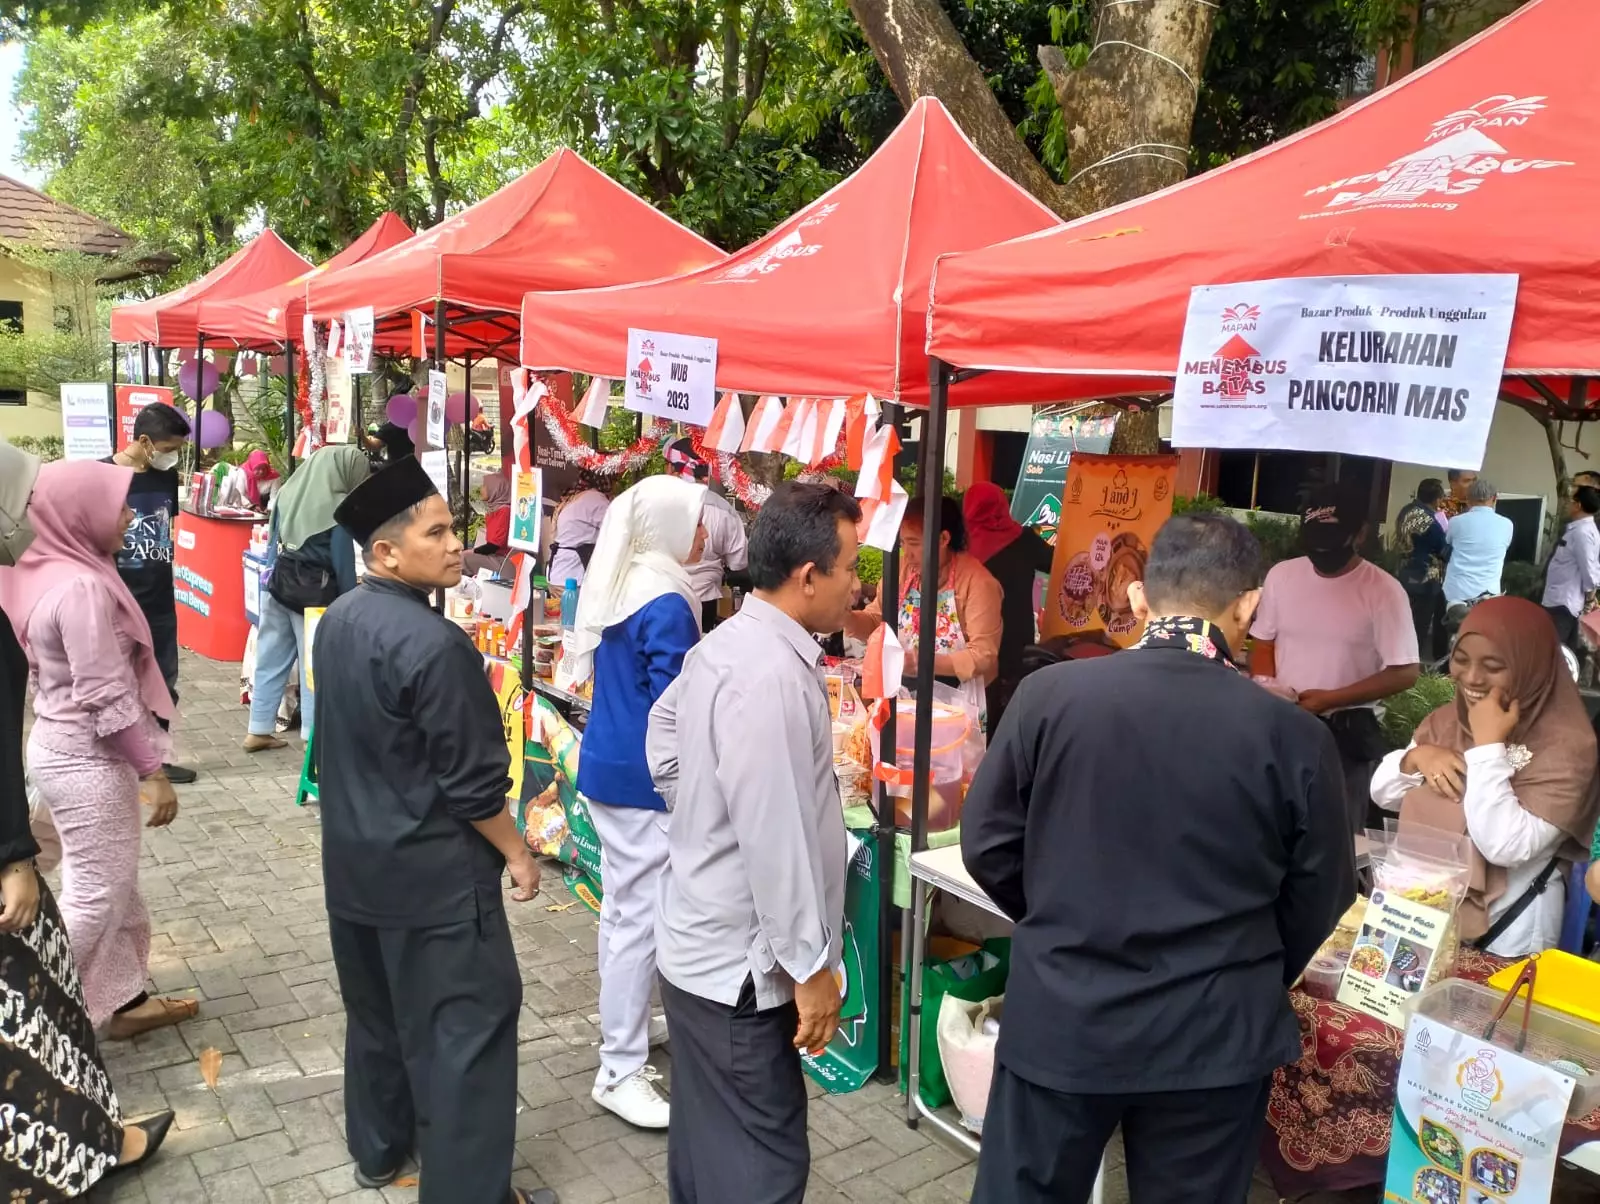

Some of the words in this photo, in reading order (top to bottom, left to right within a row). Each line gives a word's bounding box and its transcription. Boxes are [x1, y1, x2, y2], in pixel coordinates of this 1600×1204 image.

[1424, 116, 1529, 142] MAPAN
[1301, 307, 1333, 318] Bazar
[1334, 305, 1373, 317] Produk
[1429, 308, 1487, 323] Unggulan
[1221, 322, 1257, 333] MAPAN
[1318, 331, 1458, 368] KELURAHAN
[670, 362, 689, 382] WUB
[1184, 357, 1287, 376] MENEMBUS
[1202, 376, 1266, 395] BATAS
[666, 389, 690, 411] 2023
[1288, 379, 1400, 415] PANCORAN
[1404, 383, 1470, 422] MAS
[1029, 450, 1056, 465] Nasi
[1026, 464, 1044, 475] Solo
[1109, 487, 1129, 505] and
[1108, 617, 1138, 636] Lumpia
[1413, 915, 1436, 930] FOOD
[1407, 1079, 1427, 1092] NASI
[1428, 1090, 1455, 1105] BAKAR
[1457, 1103, 1485, 1119] DAPUR
[1487, 1117, 1513, 1133] MAMA
[1516, 1131, 1546, 1148] INONG
